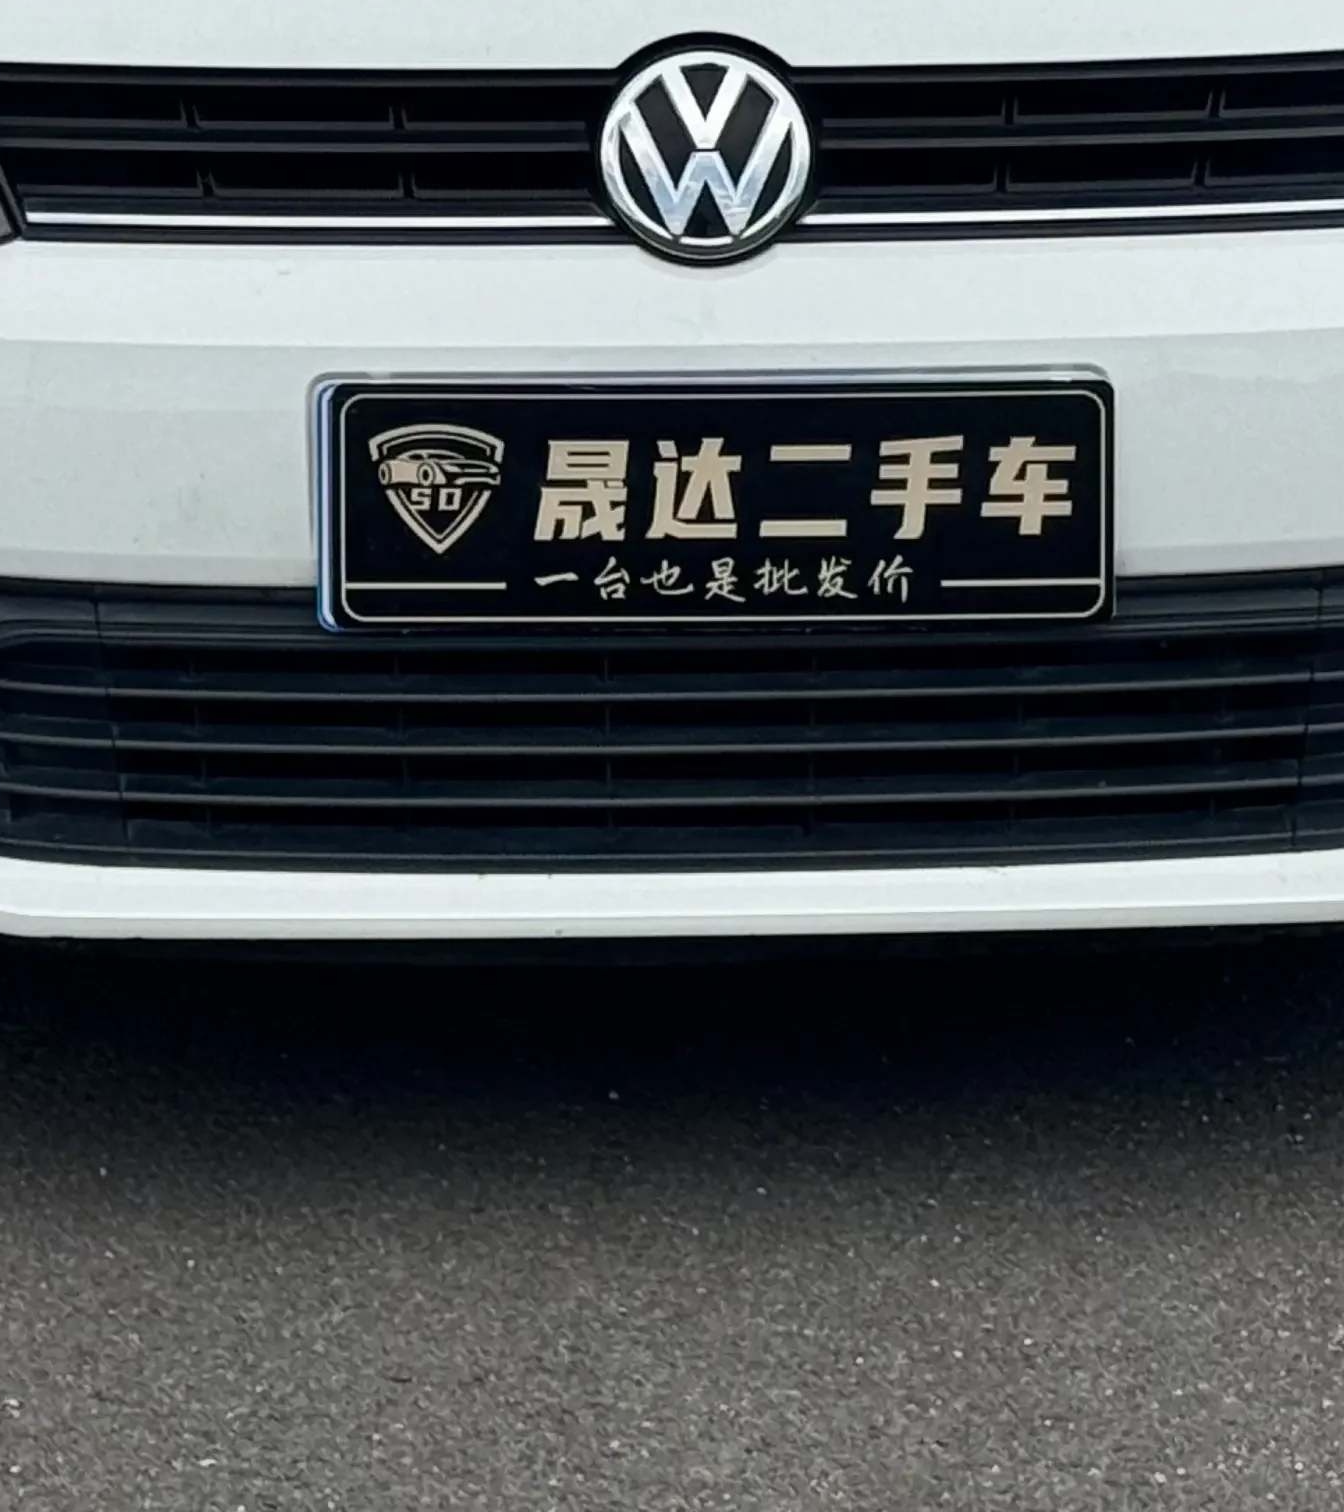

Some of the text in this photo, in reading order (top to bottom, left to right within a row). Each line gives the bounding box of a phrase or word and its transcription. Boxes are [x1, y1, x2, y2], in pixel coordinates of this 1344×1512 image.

[533, 435, 1076, 541] 晟达二手车
[533, 554, 913, 603] 一台也是批发价
